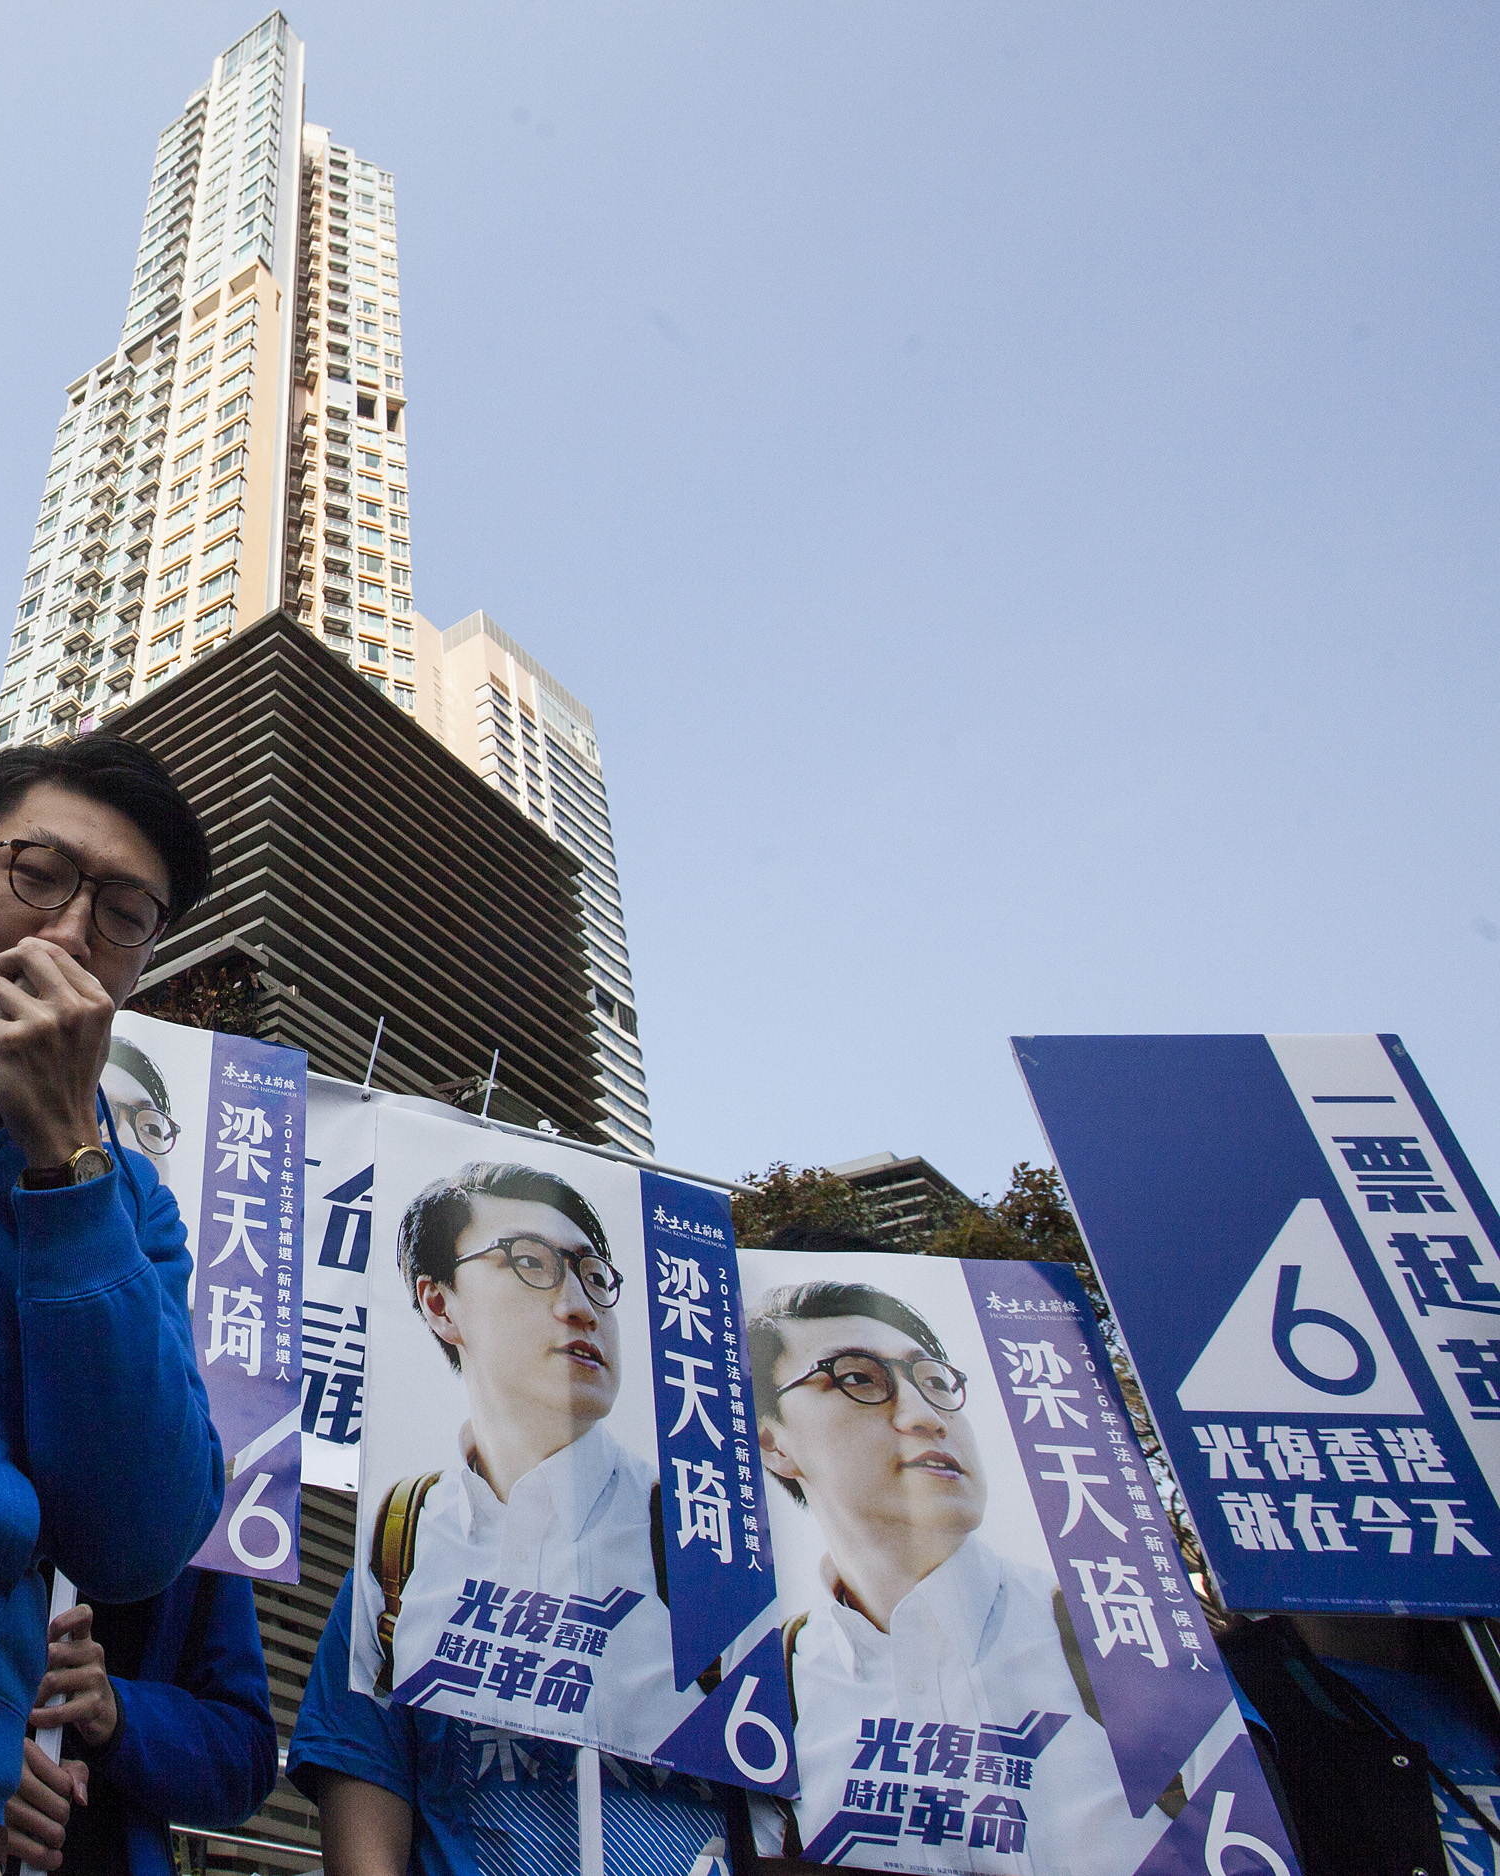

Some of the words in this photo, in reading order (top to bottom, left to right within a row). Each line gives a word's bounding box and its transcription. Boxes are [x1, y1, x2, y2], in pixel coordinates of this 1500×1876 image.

[221, 1061, 297, 1091] 本土民主前線
[205, 1100, 273, 1377] 梁天琦
[652, 1204, 726, 1241] 本土民主前線
[985, 1290, 1081, 1314] 本土民主前線
[1270, 1265, 1377, 1396] 6
[656, 1248, 732, 1563] 梁天琦
[1191, 1425, 1456, 1484] 光復香港
[228, 1471, 292, 1571] 6
[998, 1337, 1170, 1668] 梁天琦
[1220, 1493, 1492, 1557] 就在今天
[724, 1674, 790, 1784] 6
